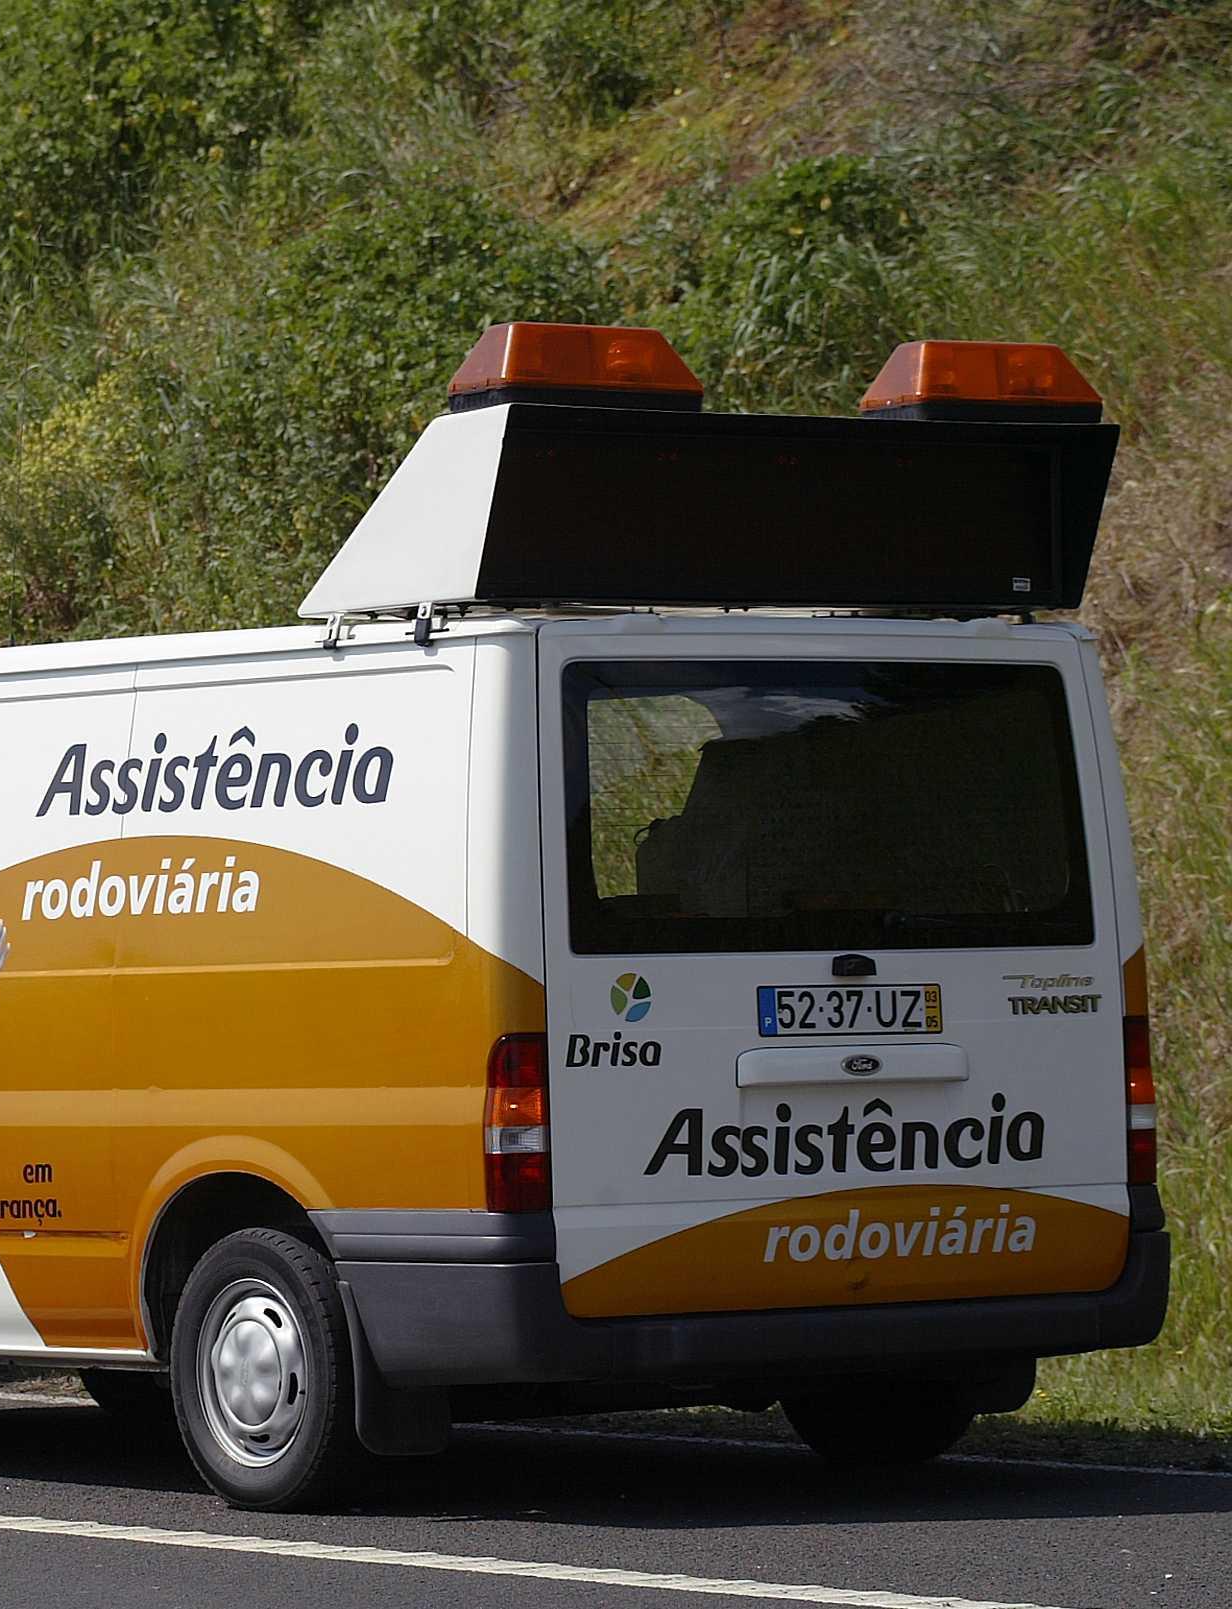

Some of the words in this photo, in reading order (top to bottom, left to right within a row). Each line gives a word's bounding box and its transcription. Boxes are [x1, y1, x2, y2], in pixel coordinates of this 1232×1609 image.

[36, 723, 393, 817] Assistência
[21, 856, 260, 921] rodoviária
[1008, 994, 1102, 1015] TRANSIT
[566, 1031, 661, 1068] Brisa
[644, 1092, 1044, 1177] Assistência
[22, 1163, 52, 1183] em
[763, 1204, 1035, 1262] rodoviária
